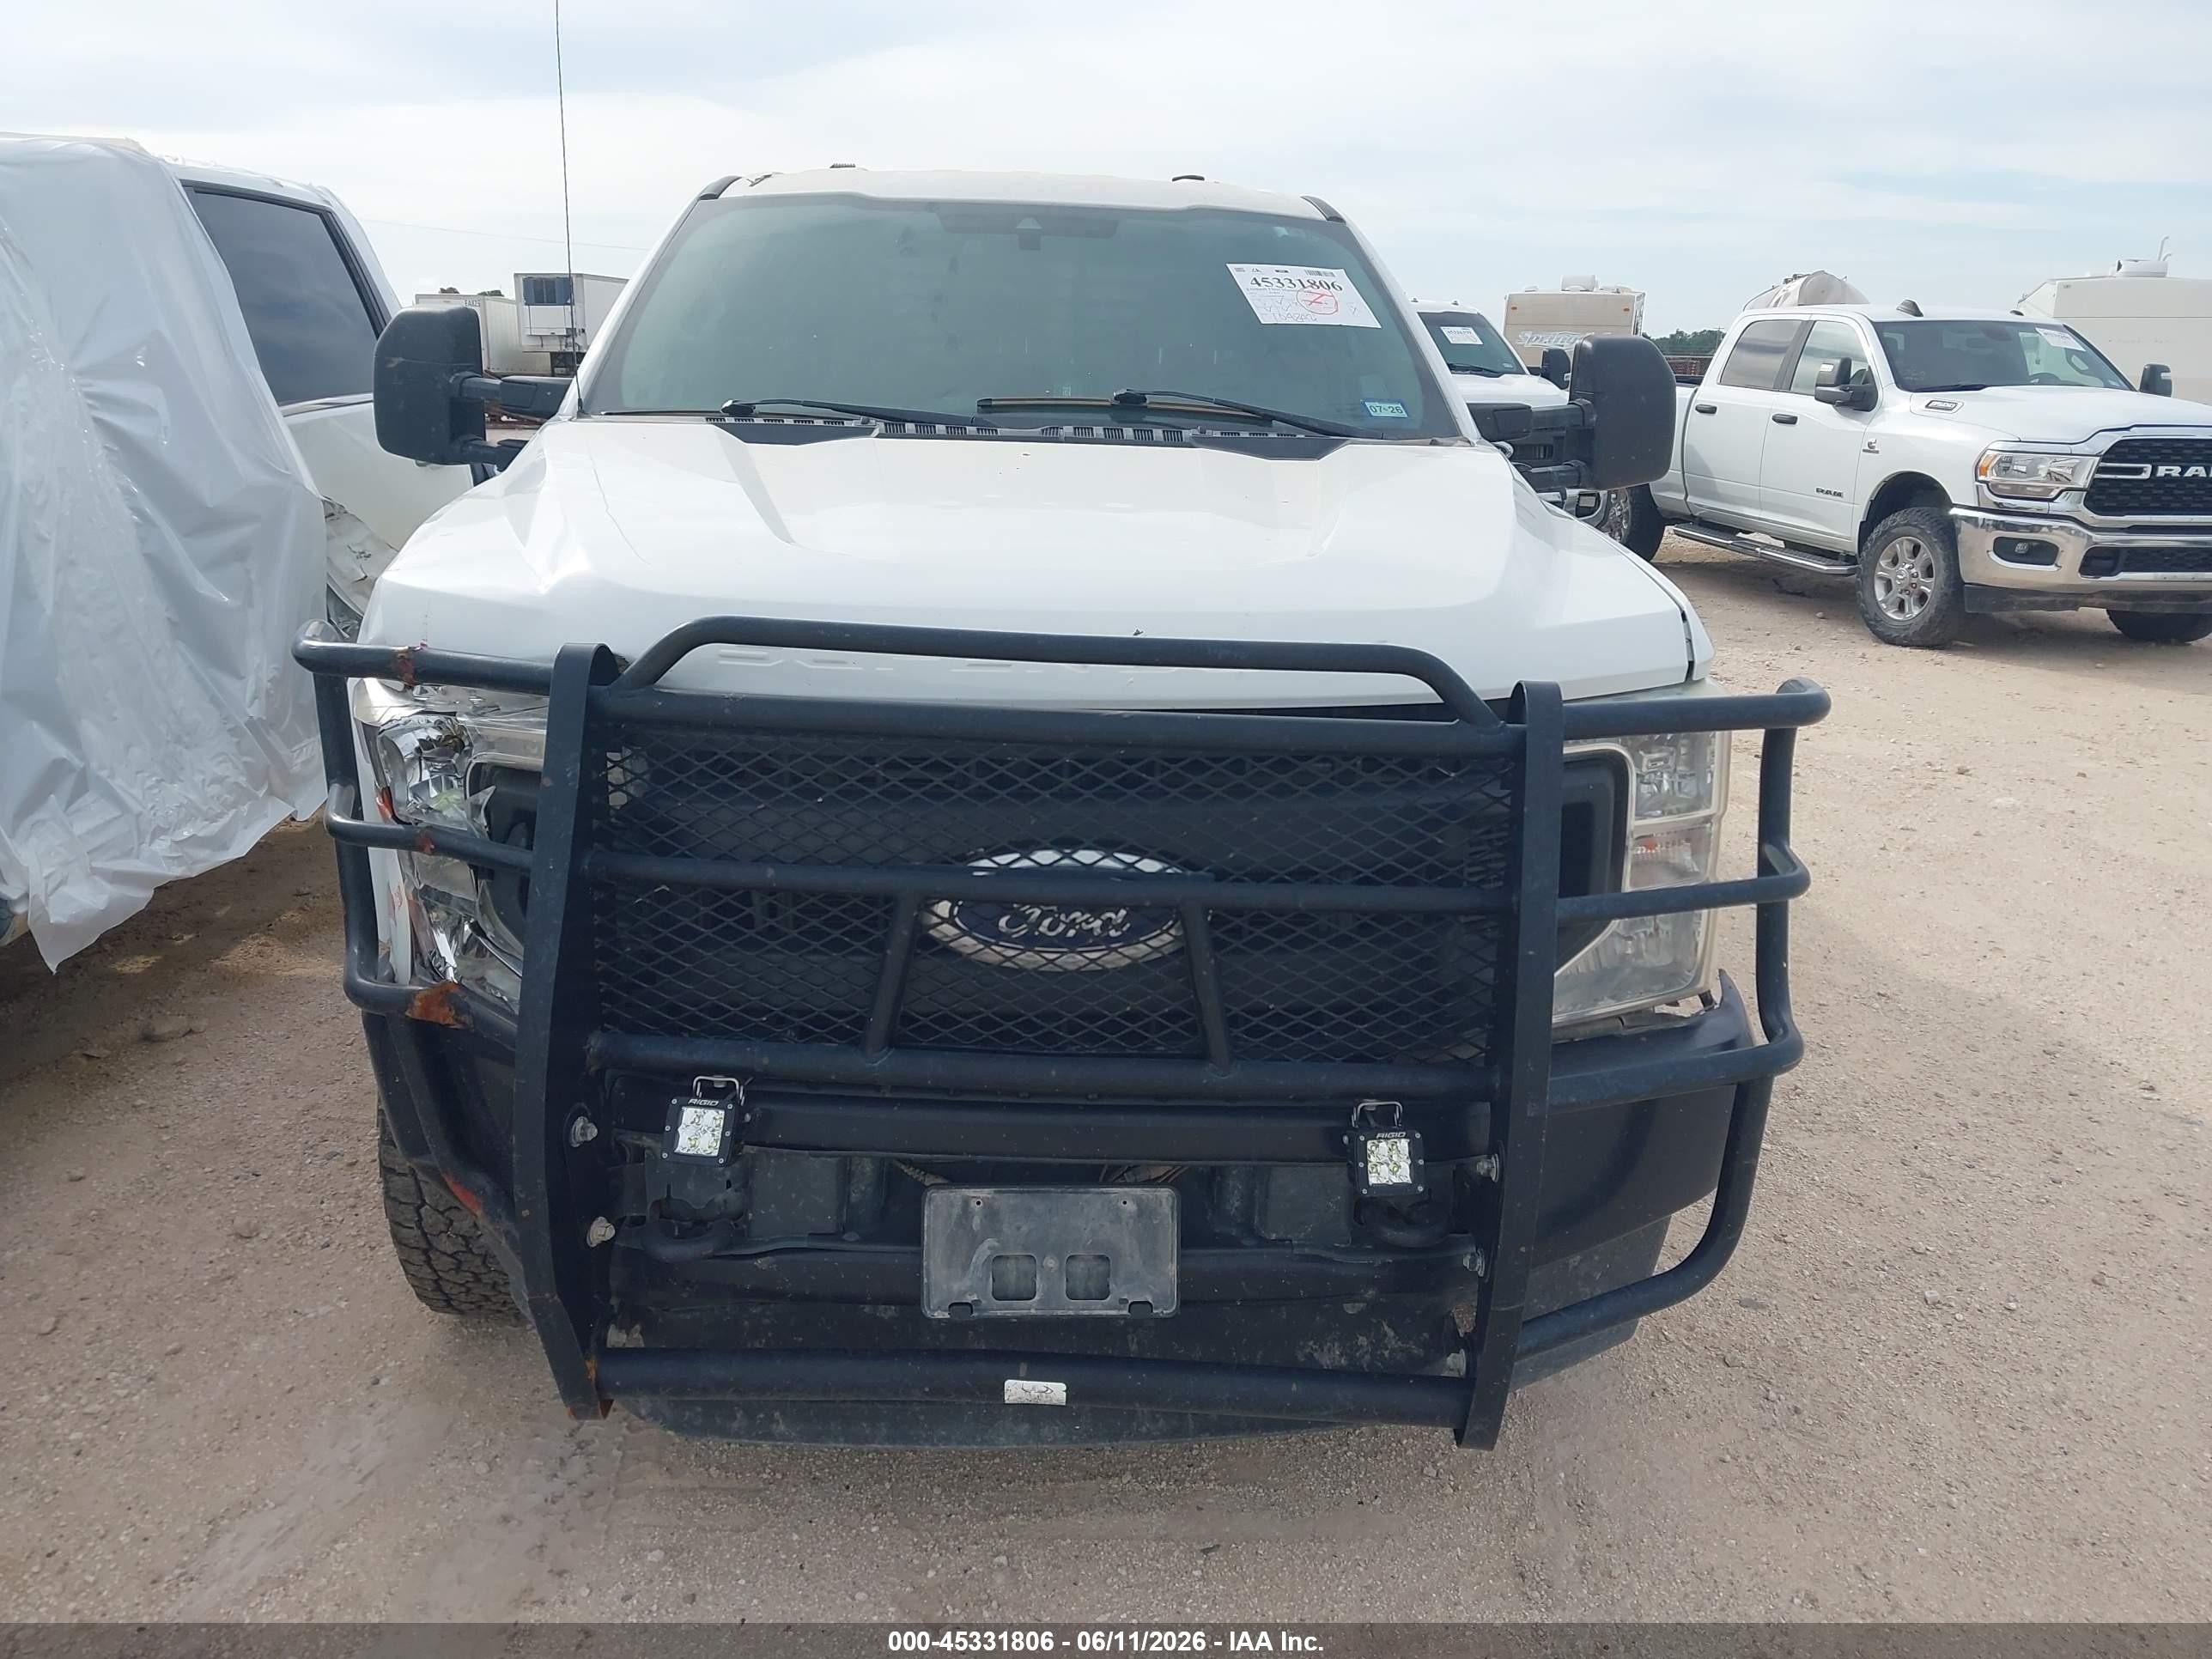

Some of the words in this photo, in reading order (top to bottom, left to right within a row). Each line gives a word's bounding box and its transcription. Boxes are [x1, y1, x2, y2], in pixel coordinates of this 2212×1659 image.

[1250, 276, 1344, 292] 45331806
[2156, 465, 2212, 477] RA
[1815, 487, 1844, 498] RAM
[998, 902, 1132, 938] Ford
[688, 1098, 720, 1107] RIGID
